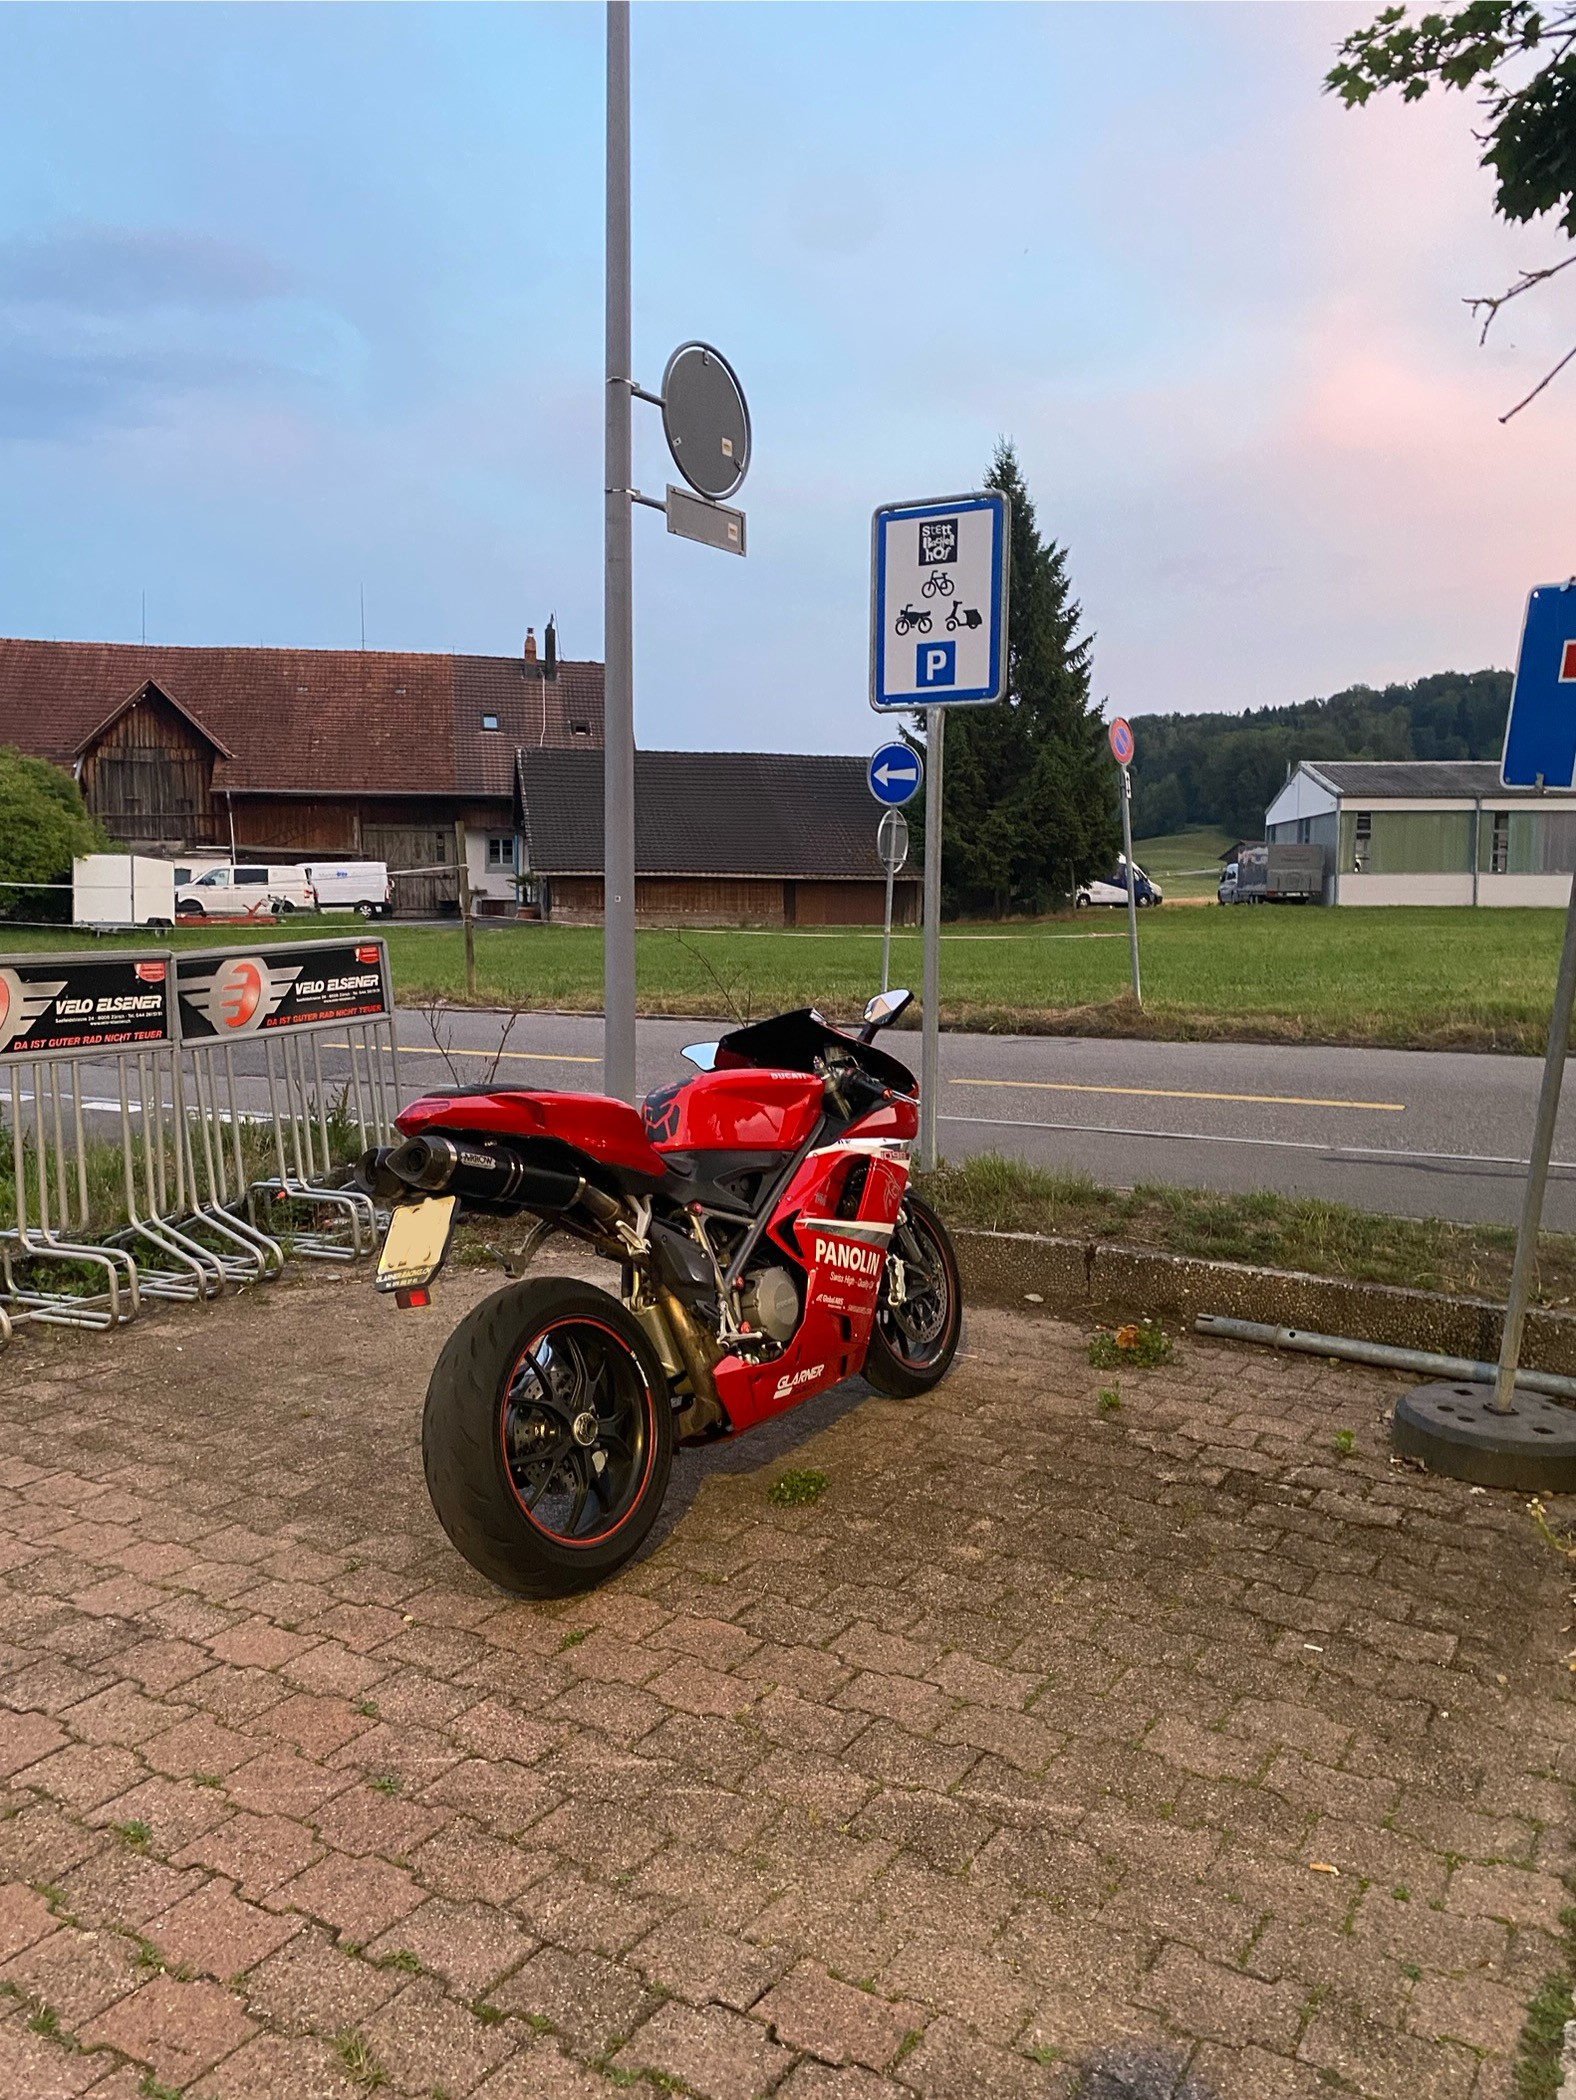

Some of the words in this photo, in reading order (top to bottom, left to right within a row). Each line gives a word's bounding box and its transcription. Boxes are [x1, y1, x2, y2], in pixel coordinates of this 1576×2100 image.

[927, 650, 947, 680] P
[295, 980, 325, 995] VELO
[326, 974, 379, 992] ELSENER
[55, 999, 94, 1015] VELO
[96, 994, 162, 1013] ELSENER
[266, 1017, 278, 1026] DA
[279, 1015, 291, 1025] IST
[293, 1012, 319, 1023] GUTER
[319, 1010, 335, 1020] RAD
[336, 1006, 358, 1017] NICHT
[358, 1003, 382, 1014] TEUER
[14, 1040, 28, 1051] DA
[30, 1038, 47, 1049] IST
[48, 1035, 81, 1048] GUTER
[82, 1034, 103, 1045] RAD
[104, 1032, 132, 1043] NICHT
[134, 1029, 163, 1041] TEUER
[770, 1072, 807, 1080] DUCATI
[815, 1238, 880, 1276] PANOLIN
[777, 1363, 825, 1390] GLARNER
